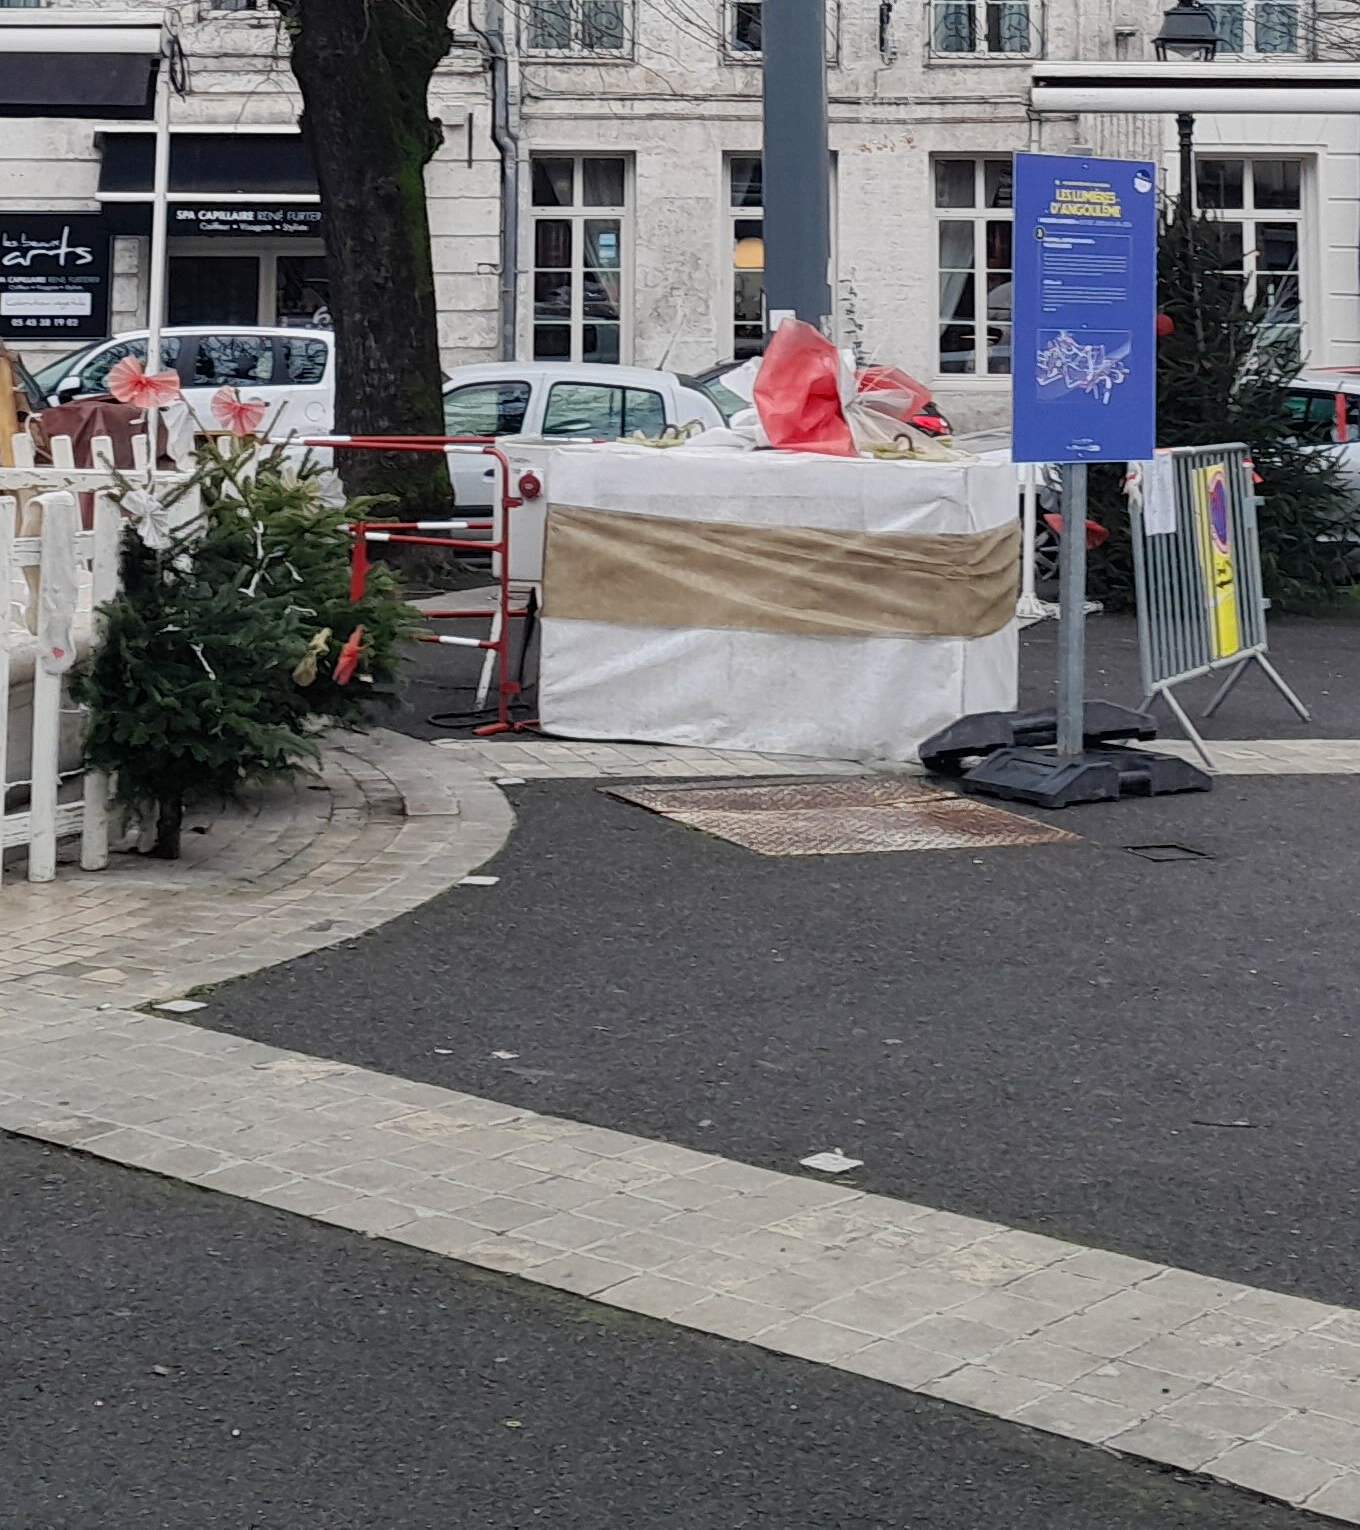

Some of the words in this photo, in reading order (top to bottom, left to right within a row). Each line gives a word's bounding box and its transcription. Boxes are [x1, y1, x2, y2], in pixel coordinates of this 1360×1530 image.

[175, 210, 196, 220] SPA
[198, 210, 255, 221] CAPILLAIRE
[1, 225, 93, 266] arts
